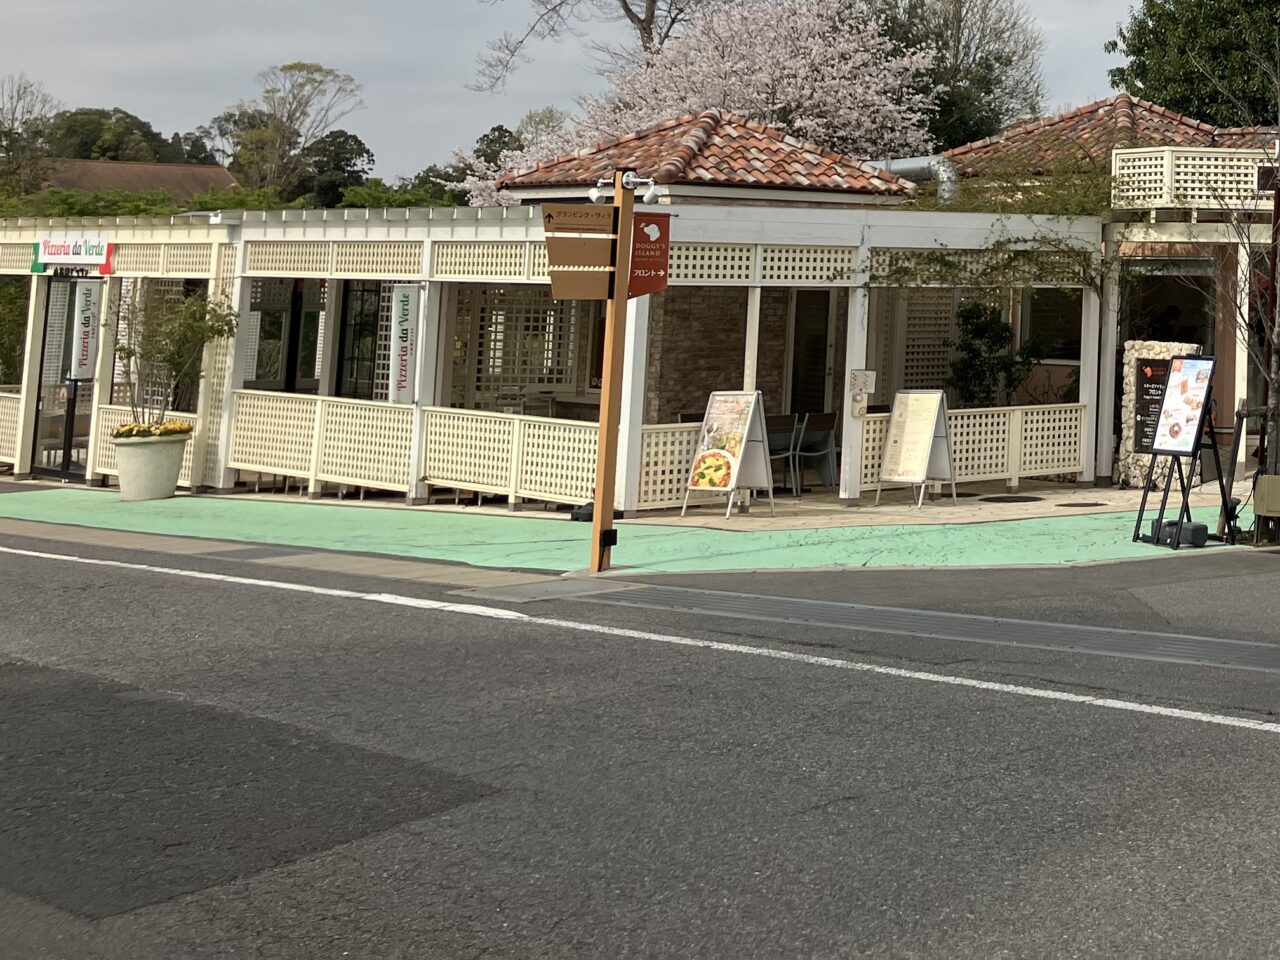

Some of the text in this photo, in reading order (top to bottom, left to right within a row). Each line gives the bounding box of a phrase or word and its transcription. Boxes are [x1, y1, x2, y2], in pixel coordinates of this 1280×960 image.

[43, 240, 104, 256] Pizzeria da Verde
[633, 269, 657, 278] フロント
[79, 287, 92, 369] Pizzeria da Verde
[396, 293, 410, 392] Pizzeria da Verde
